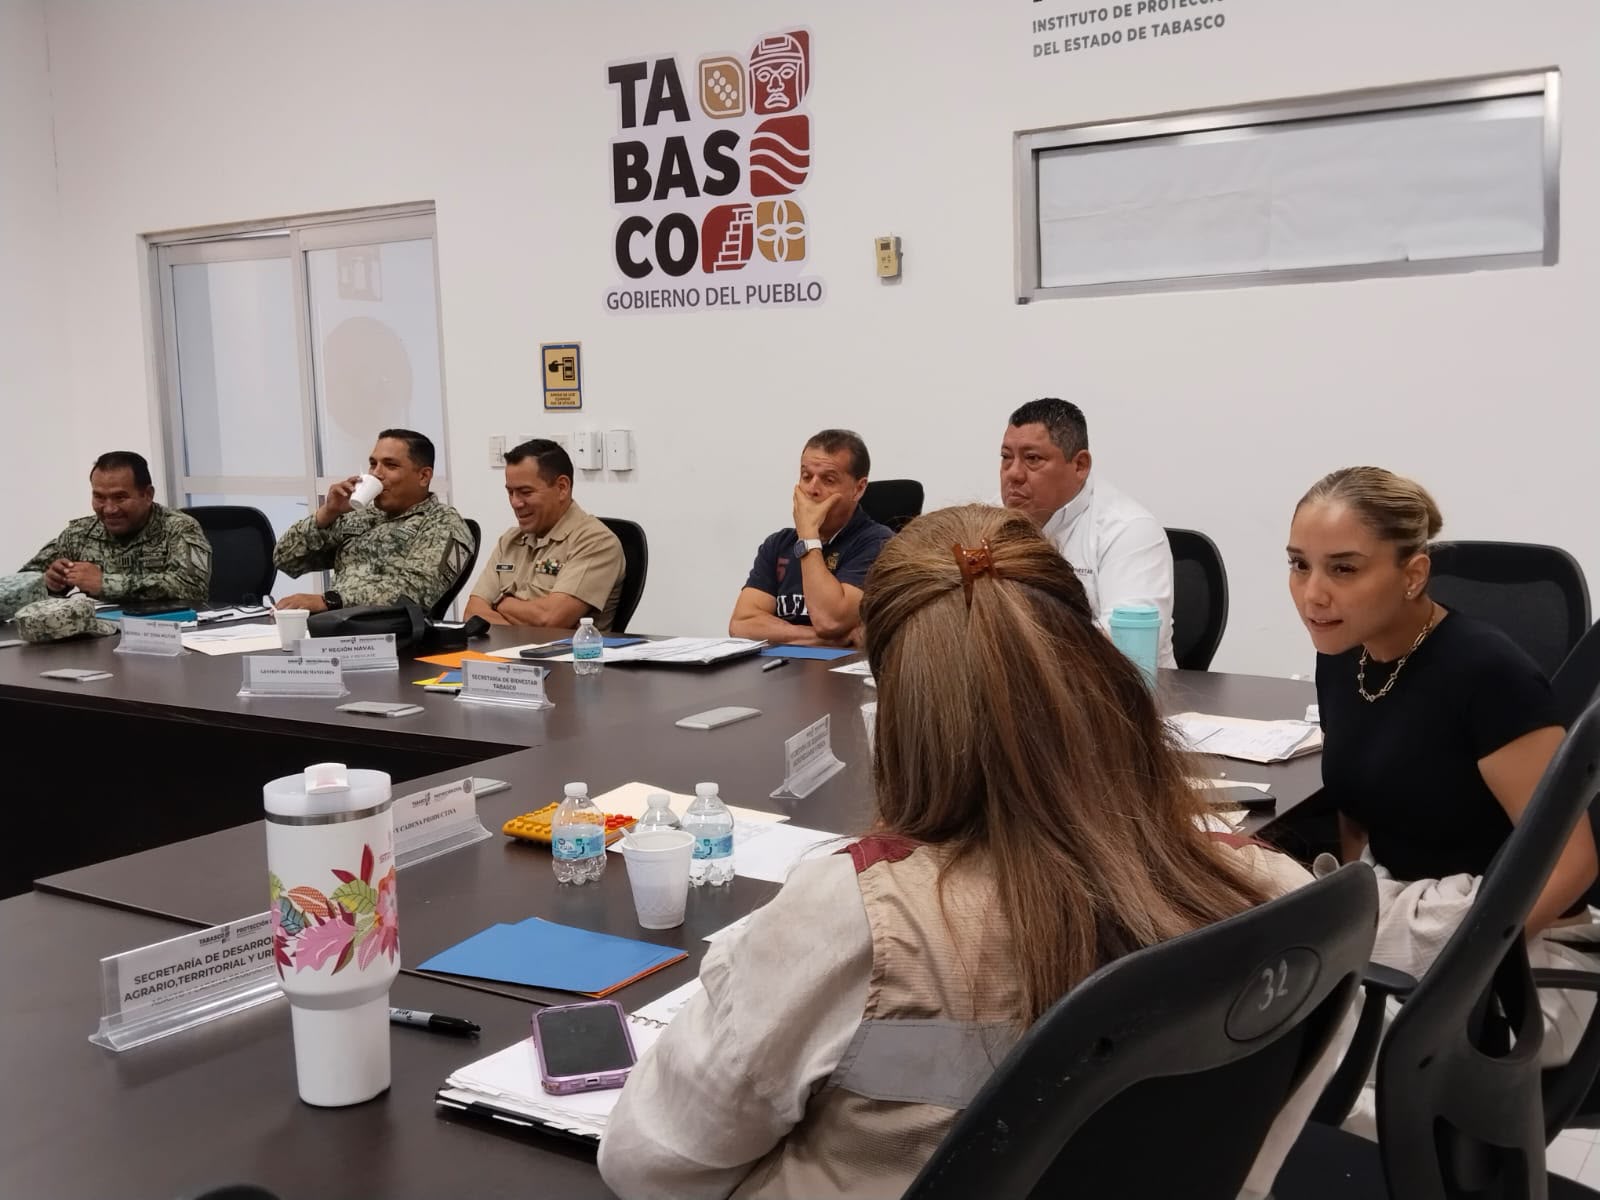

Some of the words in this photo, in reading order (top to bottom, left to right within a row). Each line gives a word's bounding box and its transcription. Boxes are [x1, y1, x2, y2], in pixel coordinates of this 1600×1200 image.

[1032, 8, 1108, 33] INSTITUTO
[1113, 4, 1133, 19] DE
[1033, 41, 1060, 58] DEL
[1064, 30, 1122, 52] ESTADO
[1127, 26, 1147, 42] DE
[1151, 14, 1226, 38] TABASCO
[608, 57, 691, 129] TA
[613, 129, 741, 204] BAS
[615, 212, 699, 279] CO
[606, 288, 700, 310] GOBIERNO
[705, 286, 741, 306] DEL
[746, 281, 822, 304] PUEBLO
[510, 678, 538, 686] BIENESTAR
[134, 955, 203, 985] SECRETARÍA
[205, 951, 220, 965] DE
[248, 954, 255, 963] Y
[1258, 959, 1289, 1011] 32
